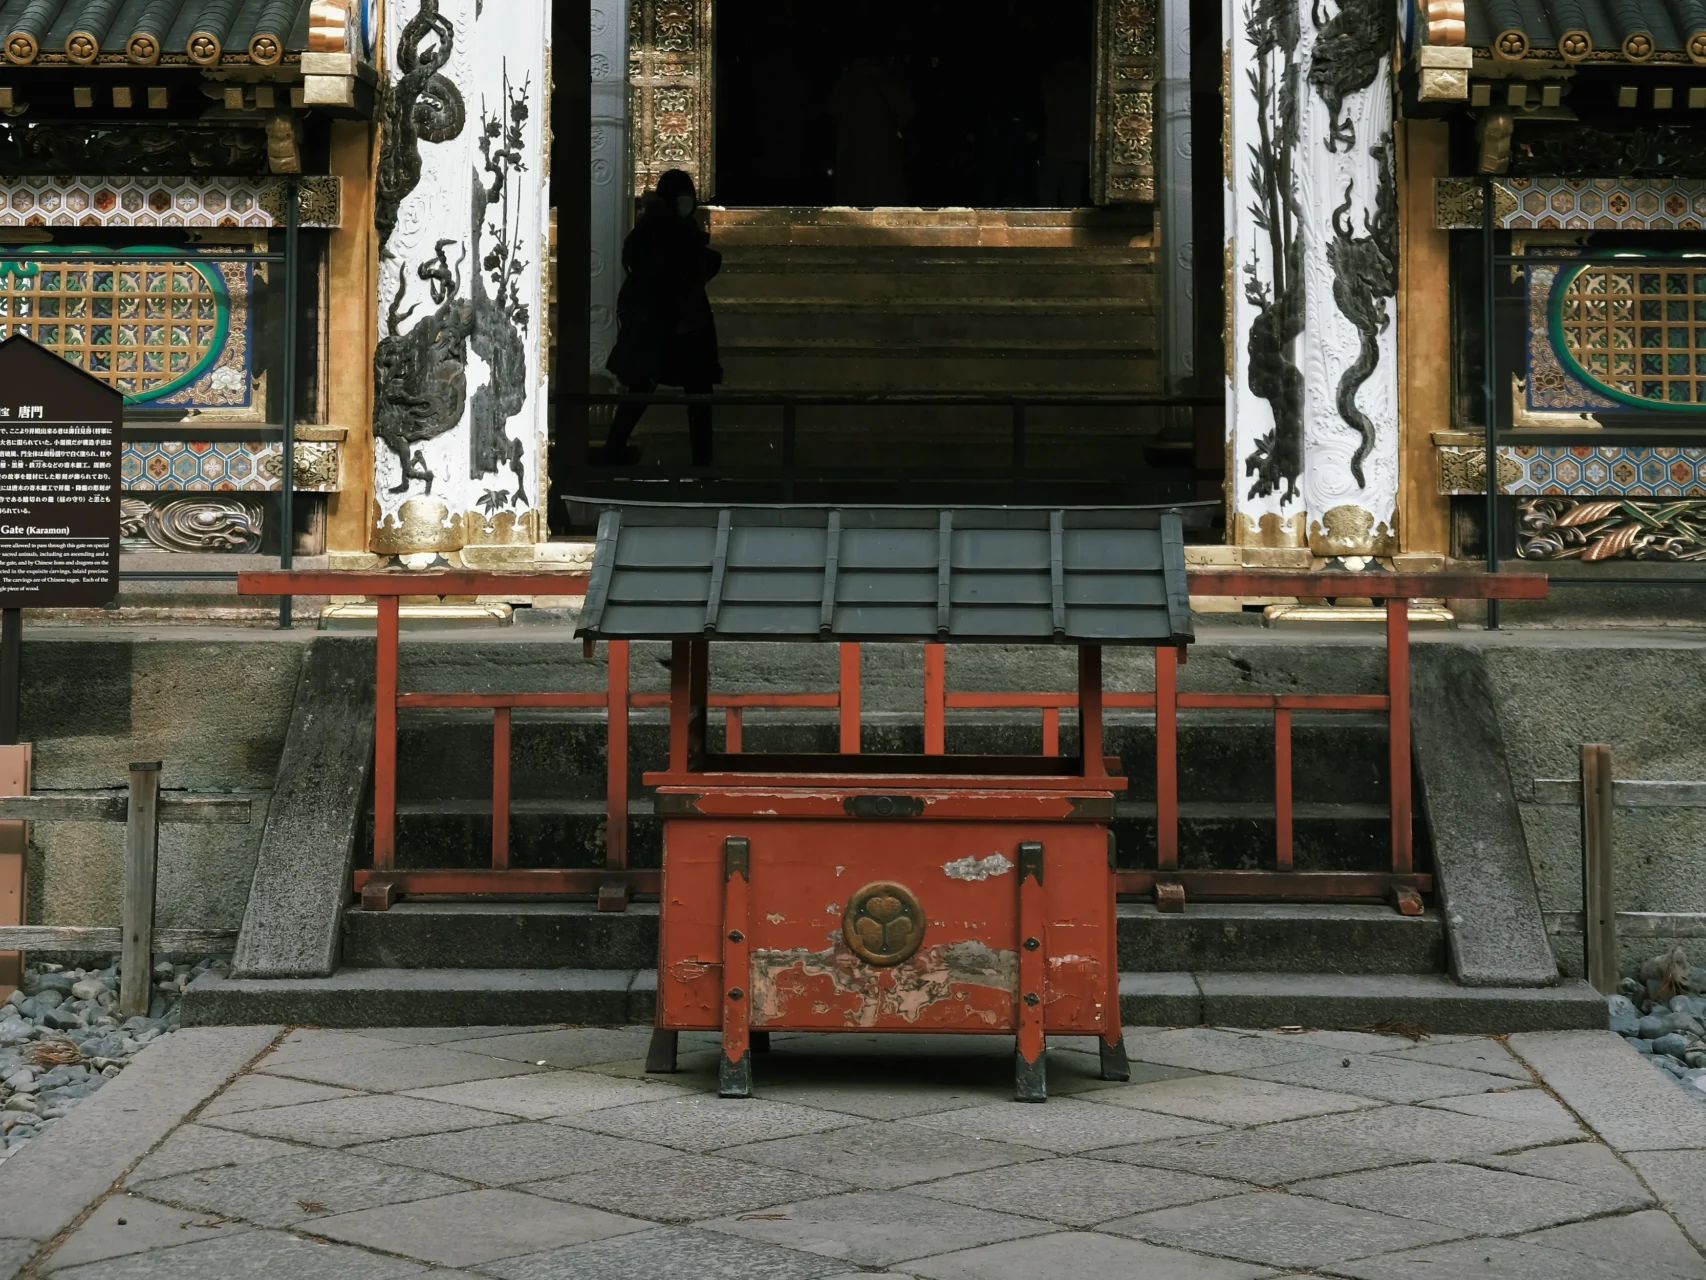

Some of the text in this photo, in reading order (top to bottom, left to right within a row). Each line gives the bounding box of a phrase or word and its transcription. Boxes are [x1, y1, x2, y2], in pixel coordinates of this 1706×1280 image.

[0, 406, 43, 418] 宝 唐門
[1, 525, 70, 536] Gate (Karamon)
